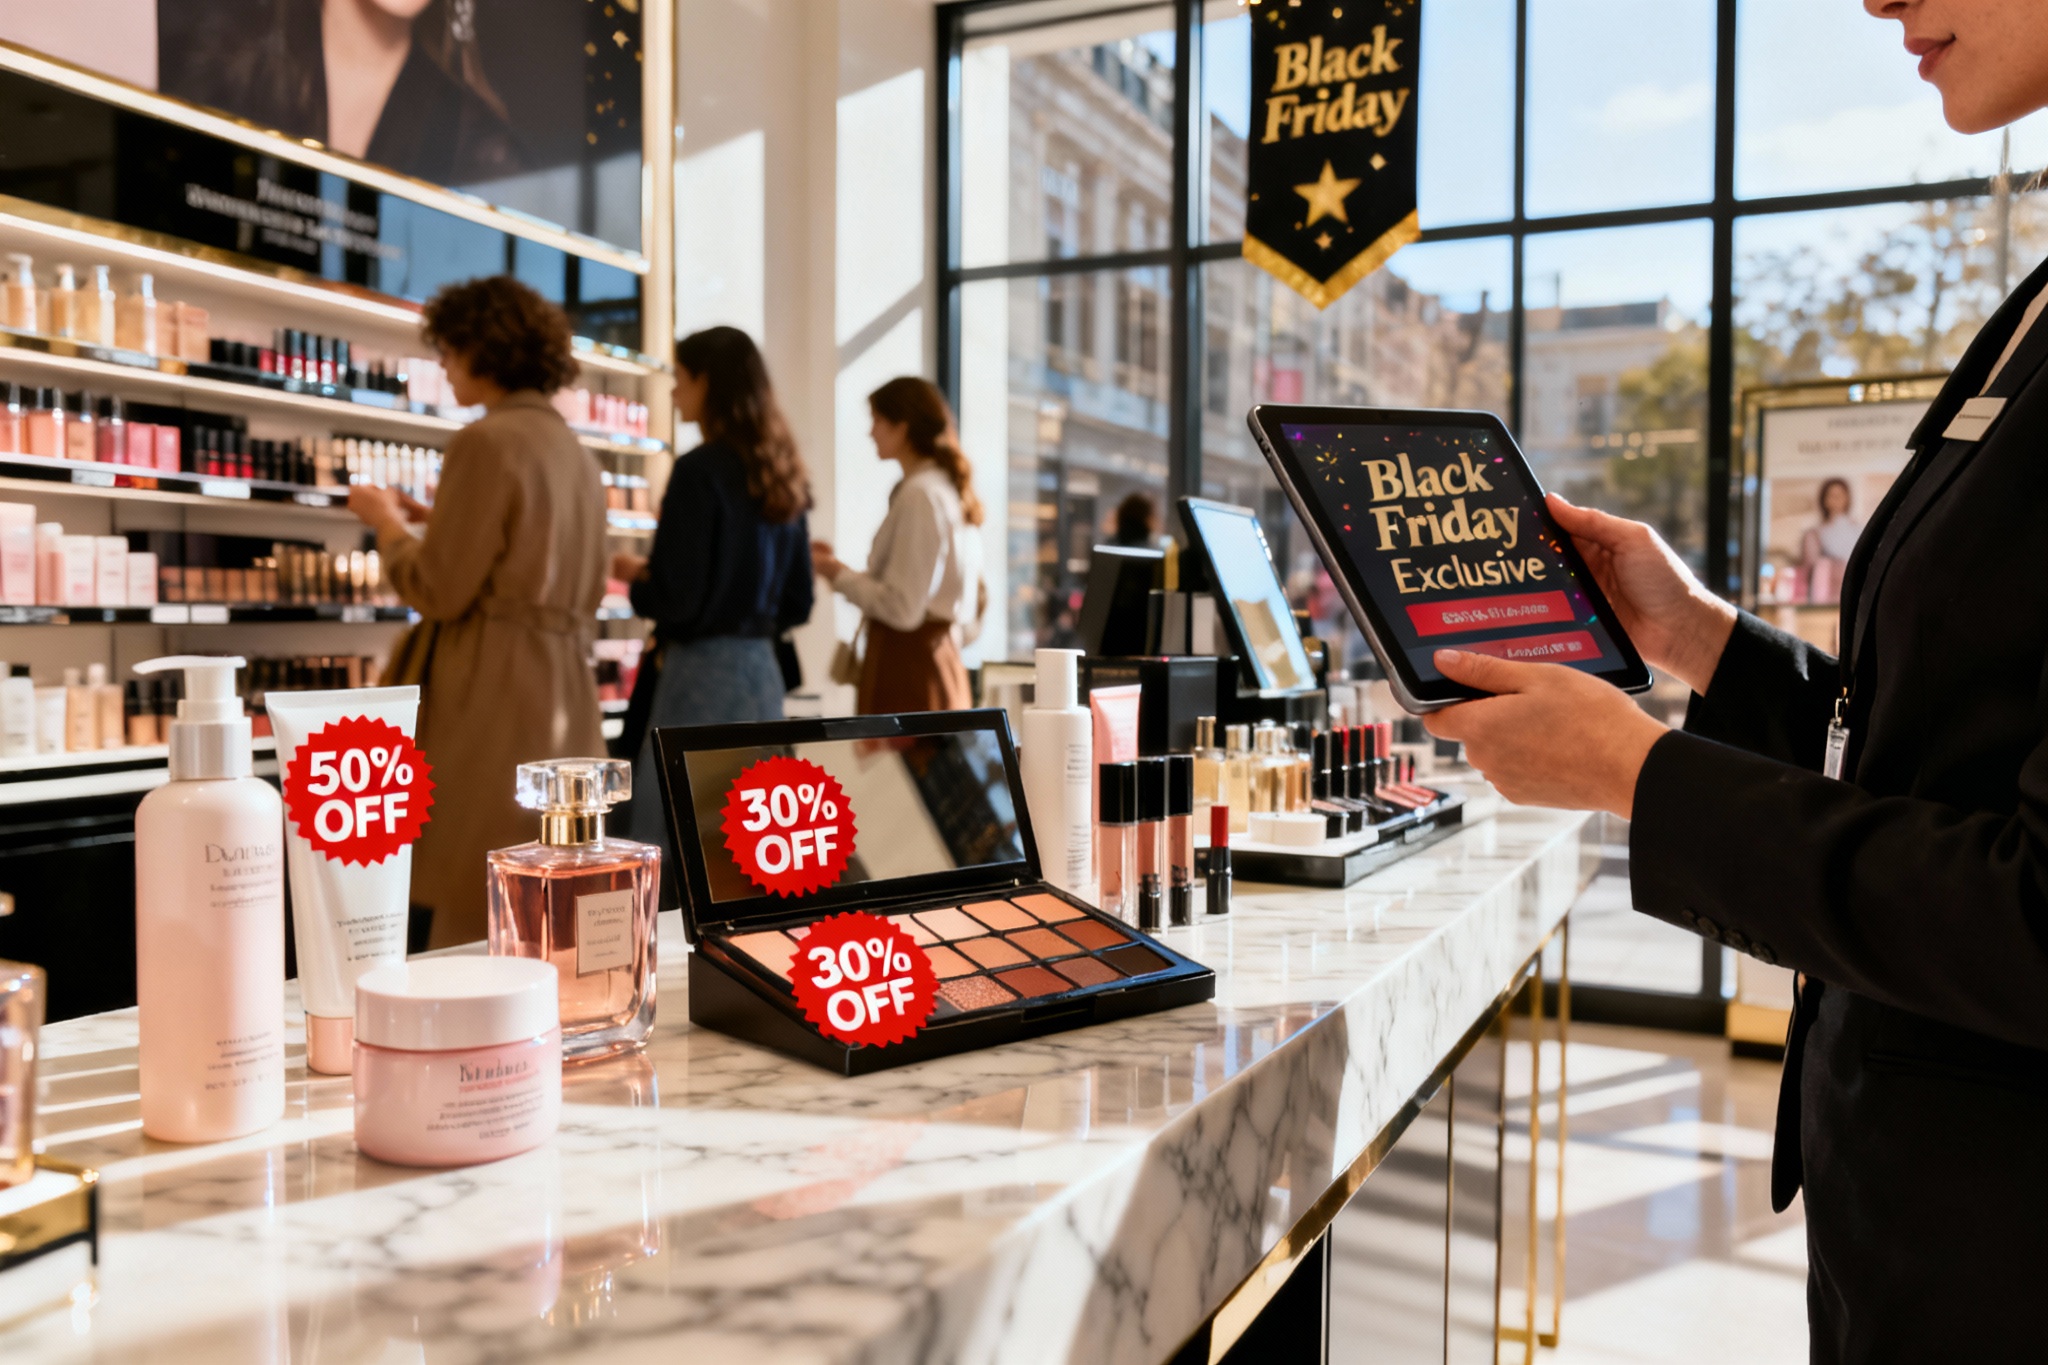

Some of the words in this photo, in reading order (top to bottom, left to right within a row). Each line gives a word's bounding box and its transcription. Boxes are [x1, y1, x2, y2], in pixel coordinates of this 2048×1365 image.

[1271, 24, 1403, 93] Black
[1261, 82, 1410, 144] Friday
[1361, 452, 1494, 503] Black
[1368, 497, 1520, 551] Friday
[1390, 551, 1547, 594] Exclusive
[307, 744, 414, 796] 50%
[314, 791, 410, 843] OFF
[740, 782, 838, 832] 30%
[754, 826, 839, 874] OFF
[807, 937, 912, 989] 30%
[826, 977, 915, 1031] OFF
